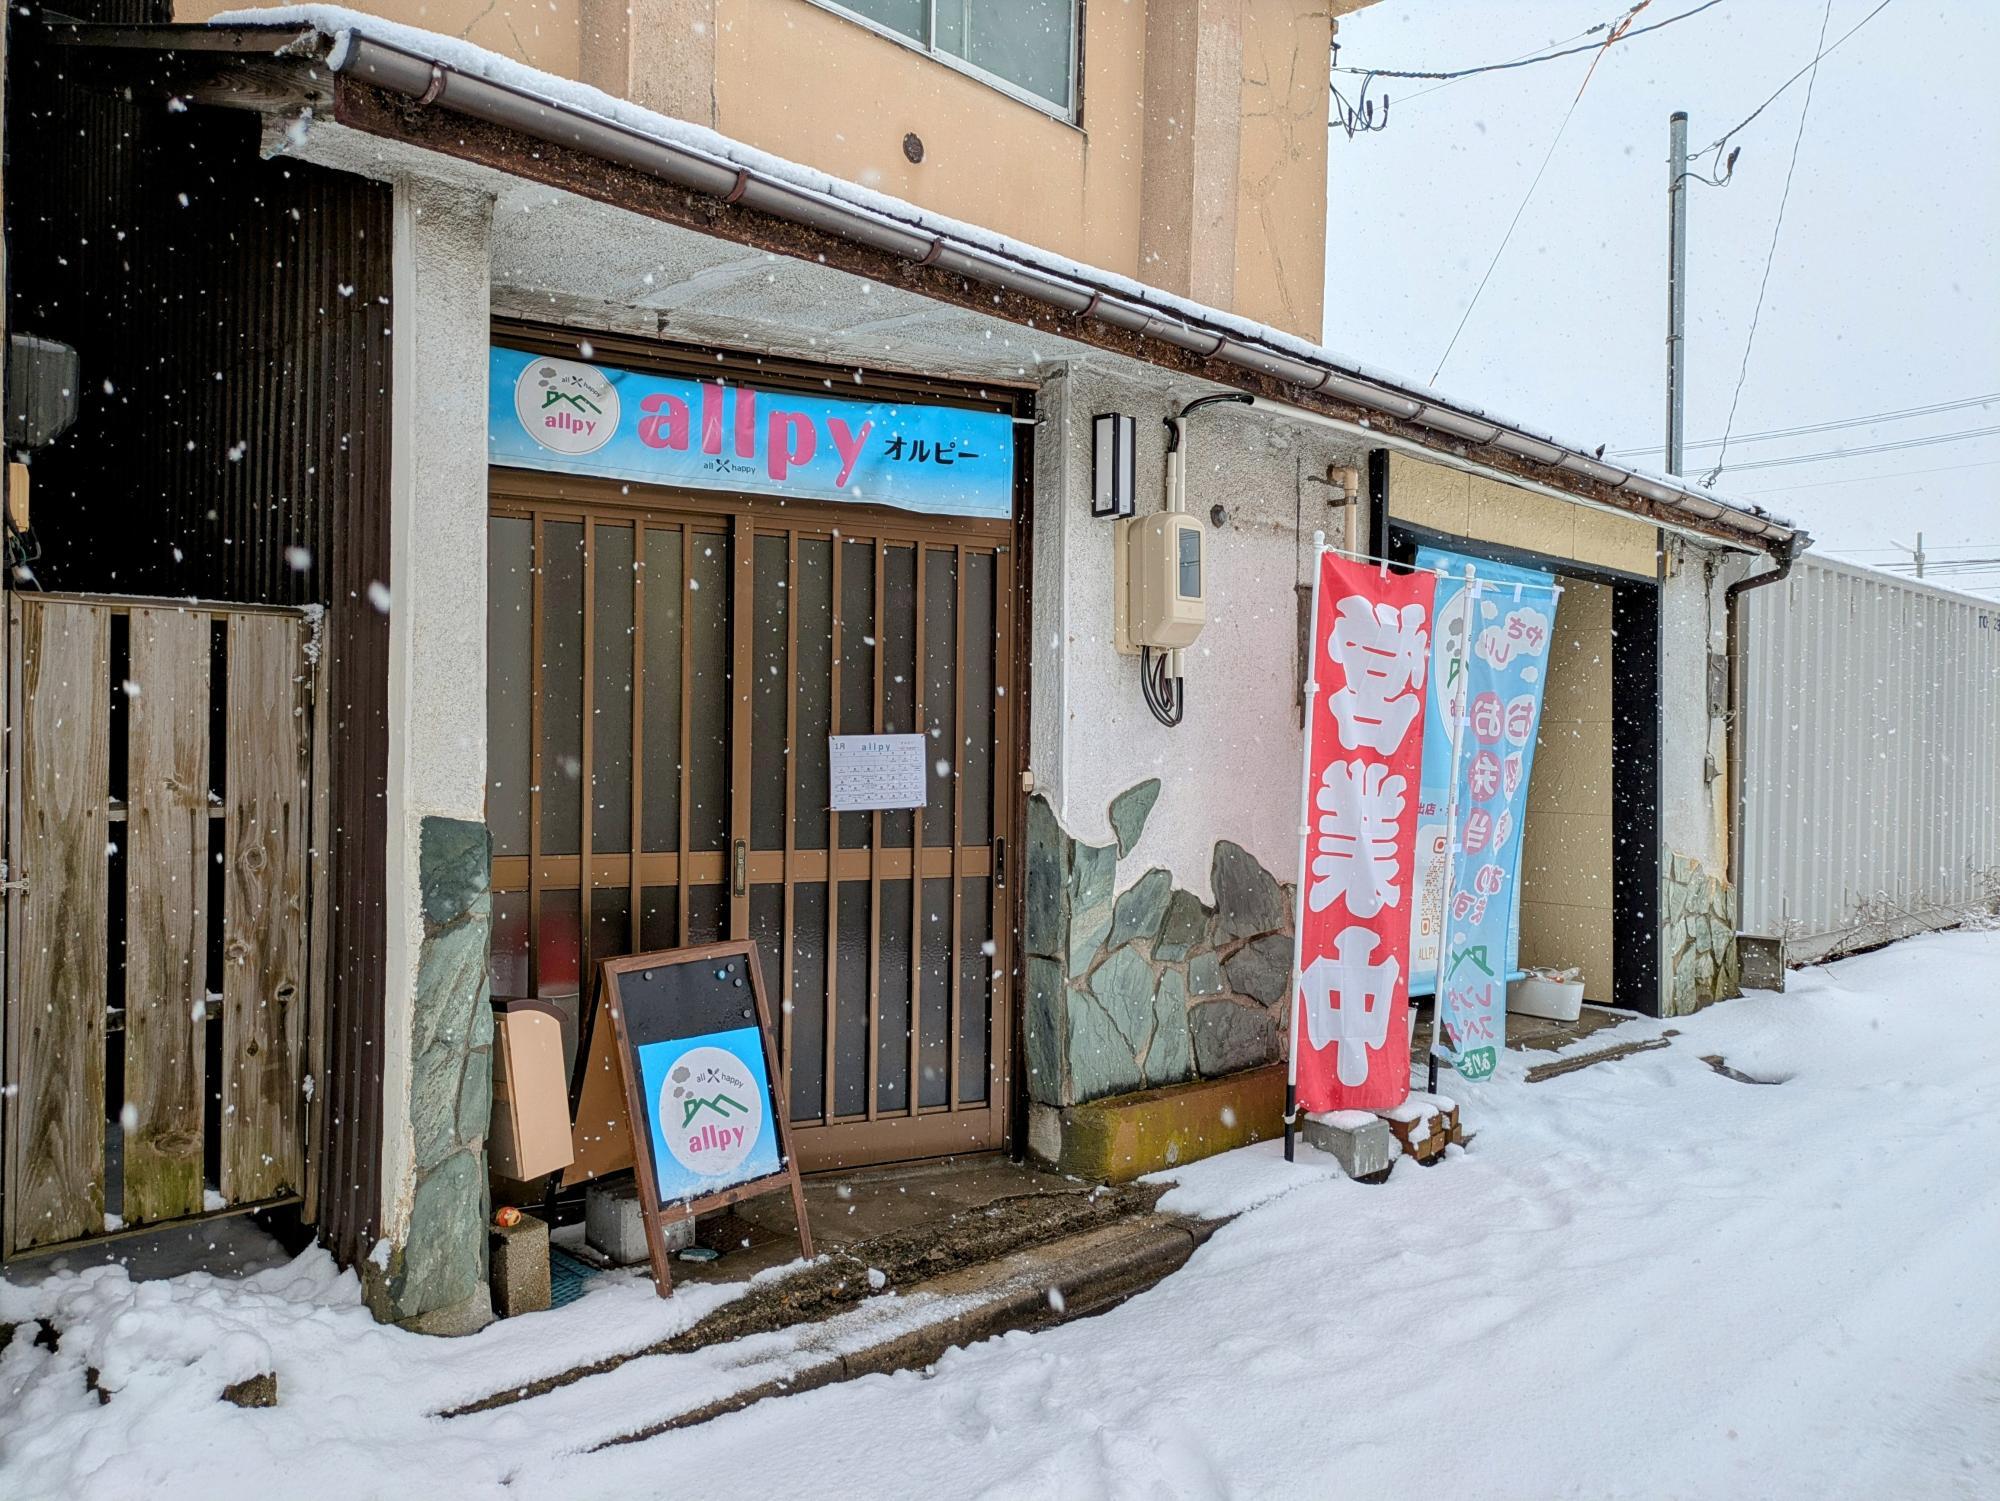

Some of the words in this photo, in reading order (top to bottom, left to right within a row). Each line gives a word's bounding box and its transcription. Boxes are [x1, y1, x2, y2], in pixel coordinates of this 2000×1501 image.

[583, 381, 601, 398] happy
[544, 412, 596, 435] allpy
[638, 383, 872, 488] allpy
[884, 436, 980, 465] オルピー
[703, 462, 714, 471] all
[732, 464, 756, 474] happy
[861, 742, 891, 751] allpy
[1300, 595, 1428, 1087] 営業中
[696, 1073, 706, 1084] all
[721, 1072, 744, 1089] happy
[688, 1124, 745, 1153] allpy
